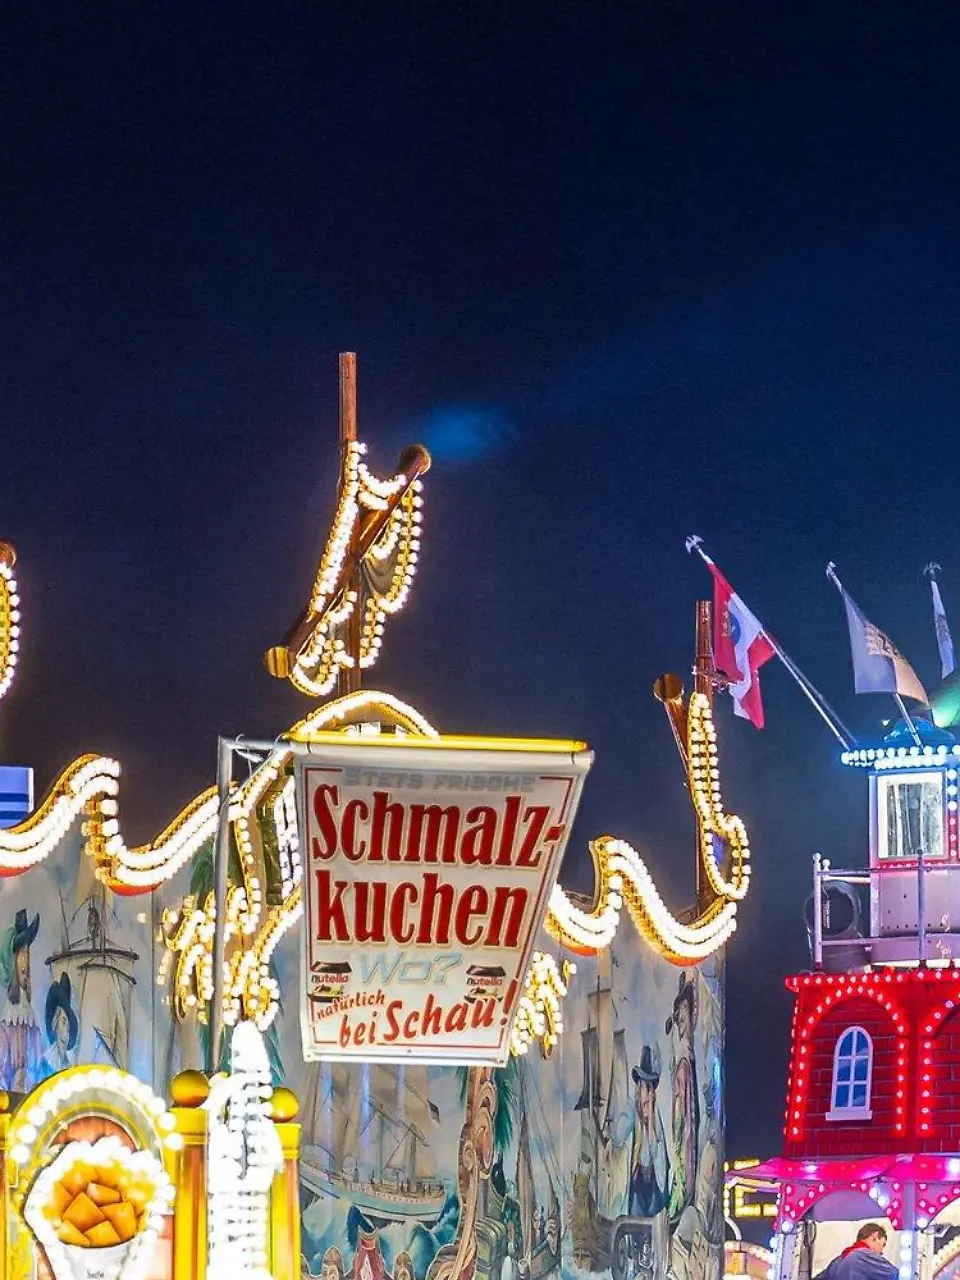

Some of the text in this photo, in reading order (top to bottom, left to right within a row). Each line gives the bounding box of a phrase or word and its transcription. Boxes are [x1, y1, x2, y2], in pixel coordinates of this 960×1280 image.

[312, 783, 565, 867] Schmalz-
[315, 870, 528, 948] kuchen
[310, 973, 349, 984] nutella
[358, 952, 463, 985] Wo?
[466, 976, 503, 987] nutella
[316, 989, 386, 1020] natürlich
[338, 978, 518, 1048] bei Schau!
